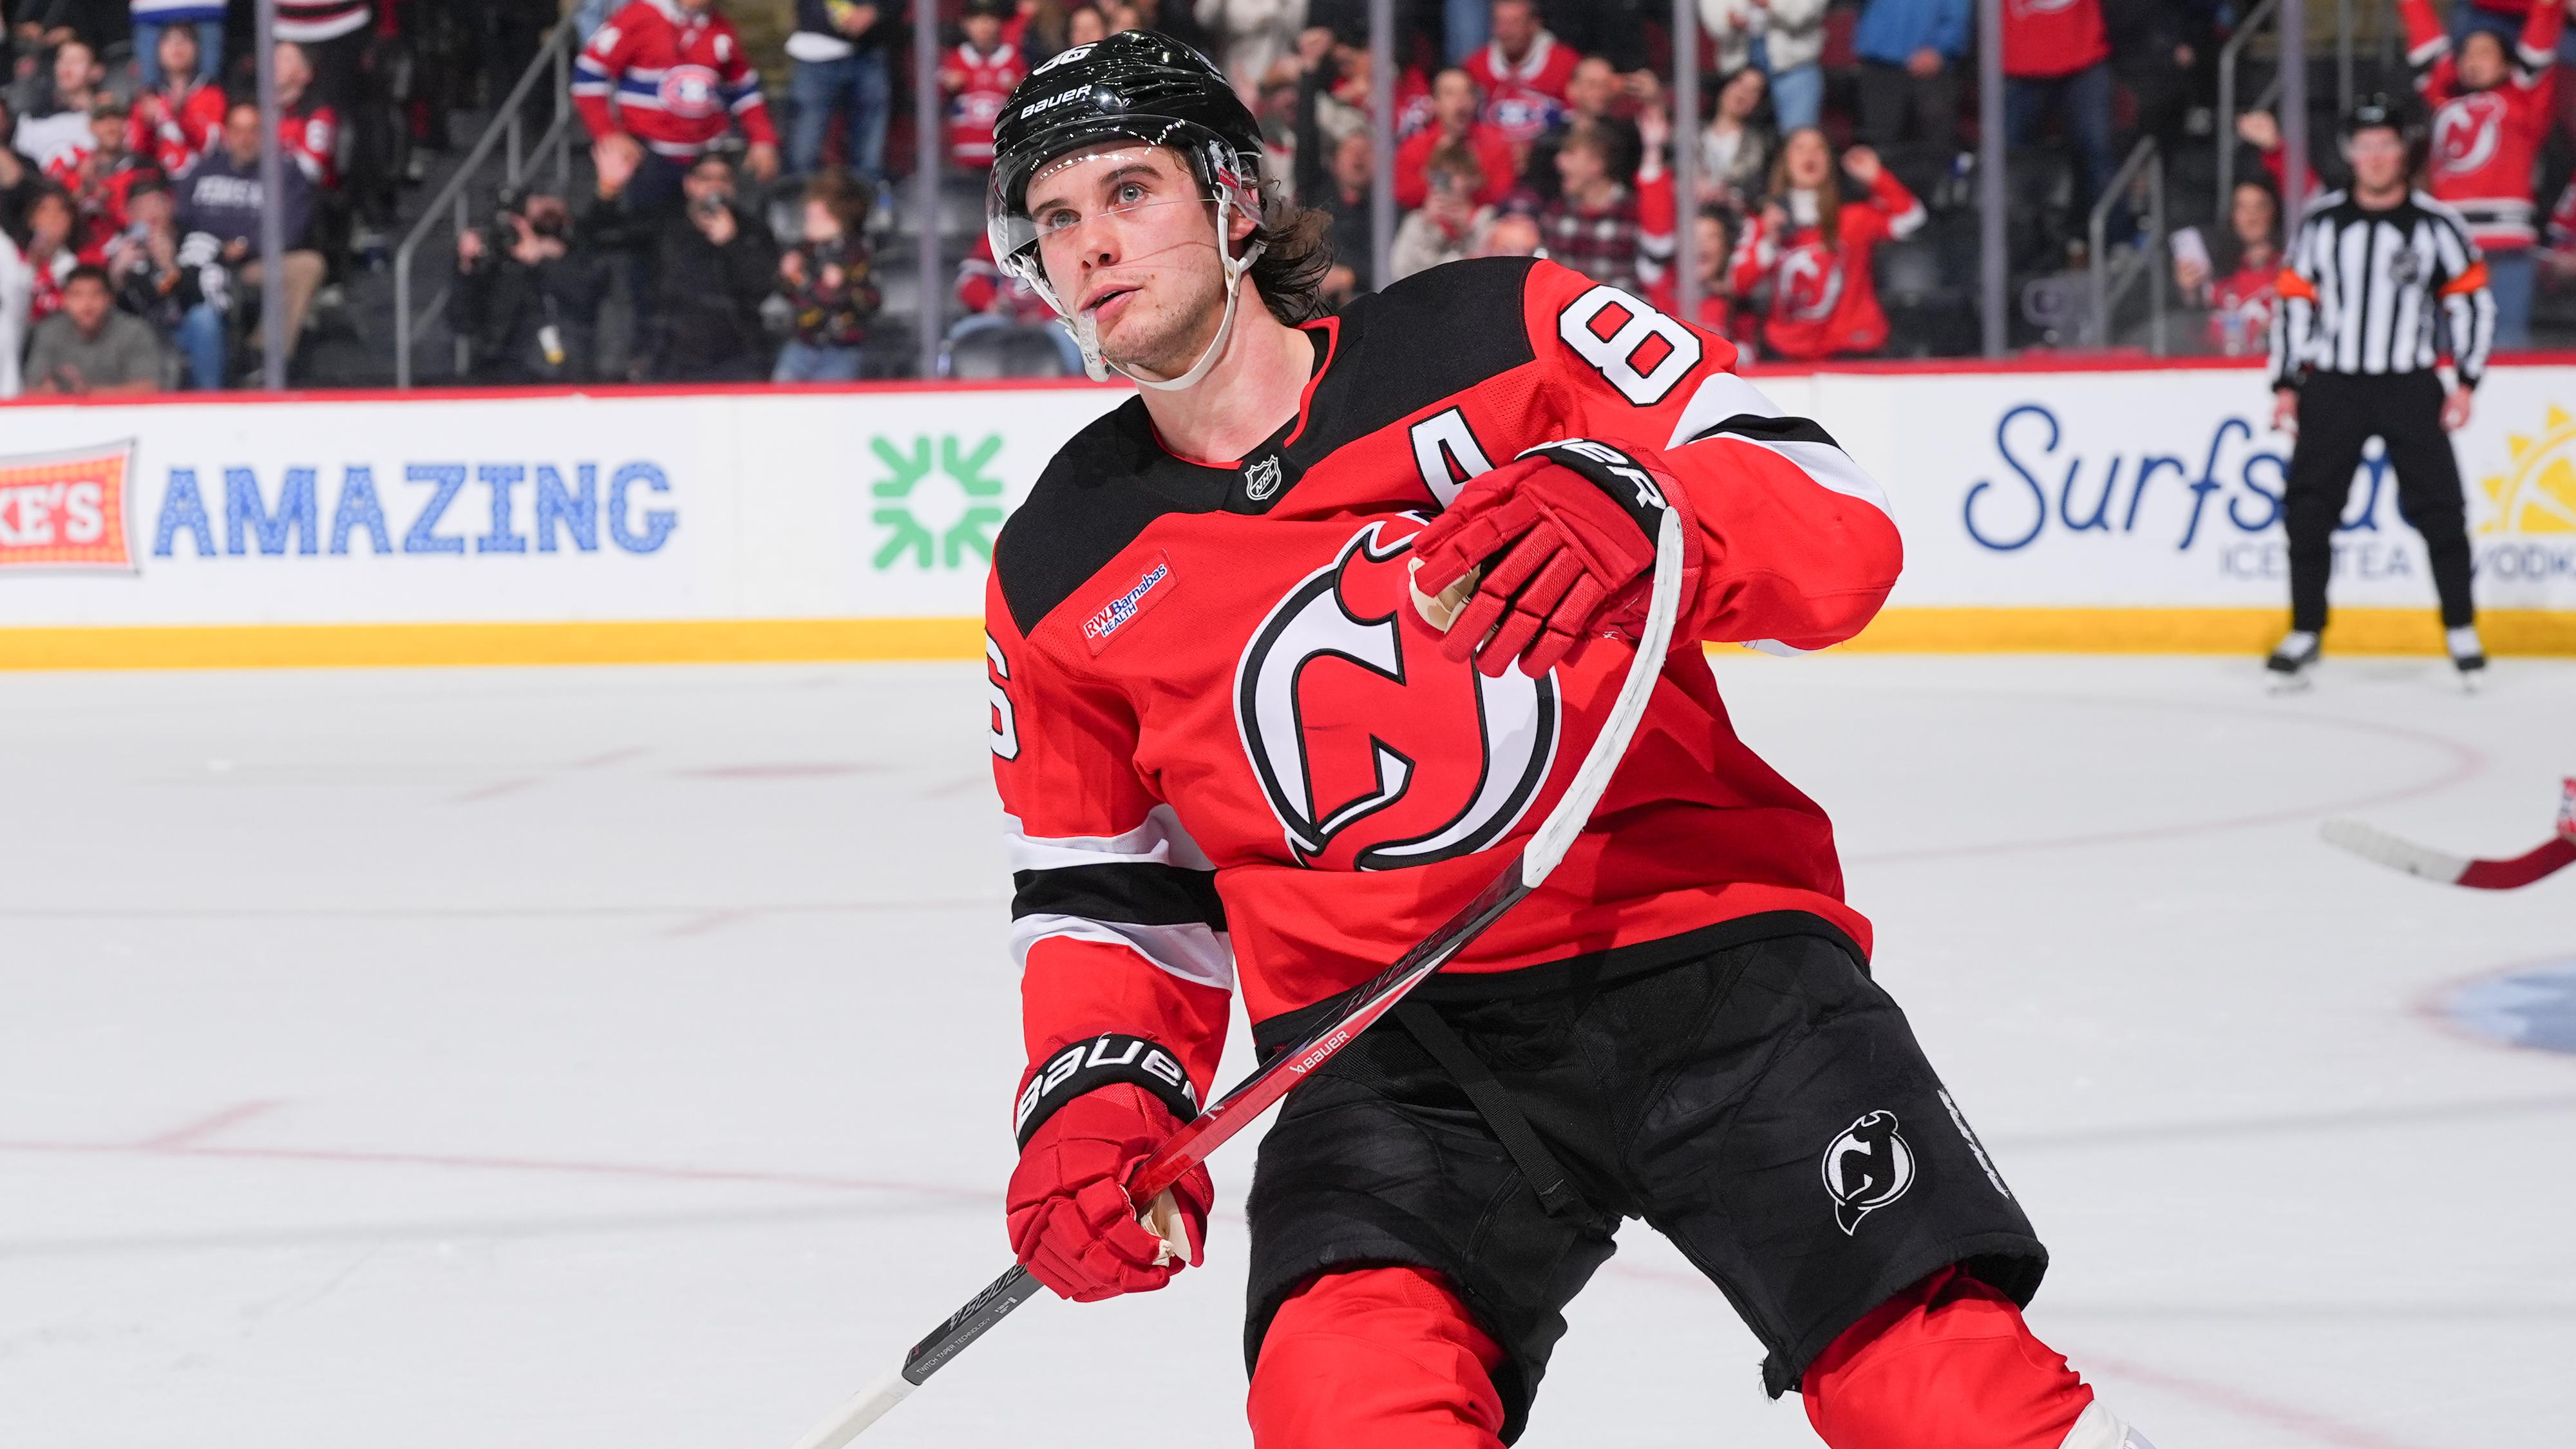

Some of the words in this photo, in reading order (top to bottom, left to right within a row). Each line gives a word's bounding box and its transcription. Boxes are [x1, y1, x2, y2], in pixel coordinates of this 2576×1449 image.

[1557, 284, 1703, 408] 8
[1408, 404, 1496, 512] A
[153, 461, 677, 557] AMAZING
[1084, 564, 1167, 638] RWJBarnabas
[1101, 609, 1137, 636] HEALTH
[1302, 1030, 1350, 1070] BAUER
[916, 1356, 939, 1374] TWITCH
[936, 1343, 956, 1359] TAPER
[954, 1317, 990, 1345] TECHNOLOGY
